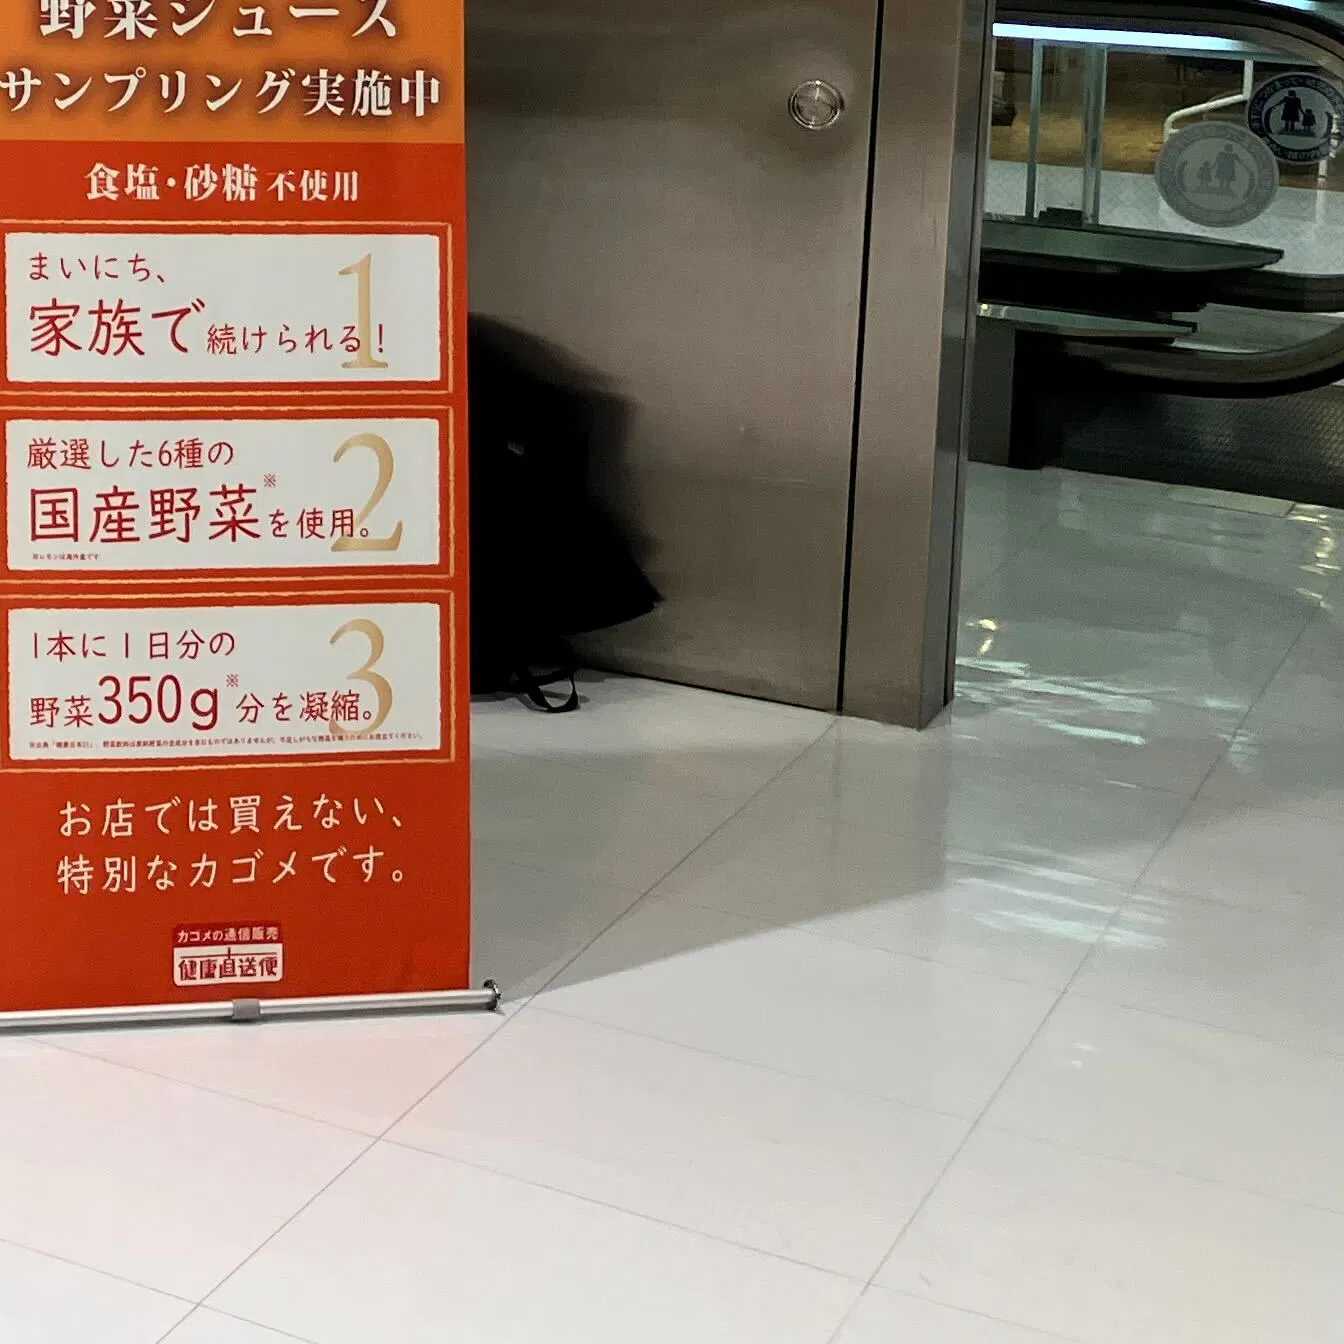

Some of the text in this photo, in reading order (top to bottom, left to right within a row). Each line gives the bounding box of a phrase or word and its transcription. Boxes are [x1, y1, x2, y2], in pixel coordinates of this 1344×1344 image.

[0, 67, 442, 118] サンプリング実施中
[29, 252, 165, 284] まいにち、
[338, 252, 388, 369] 1
[27, 437, 234, 469] 厳選した6種の
[330, 432, 403, 553] 2
[328, 618, 394, 737] 3
[58, 793, 402, 839] お店では買えない、
[57, 845, 404, 895] 特別なカゴメです。
[177, 926, 279, 943] カゴメの通信販売
[178, 949, 279, 981] 健康直送便
